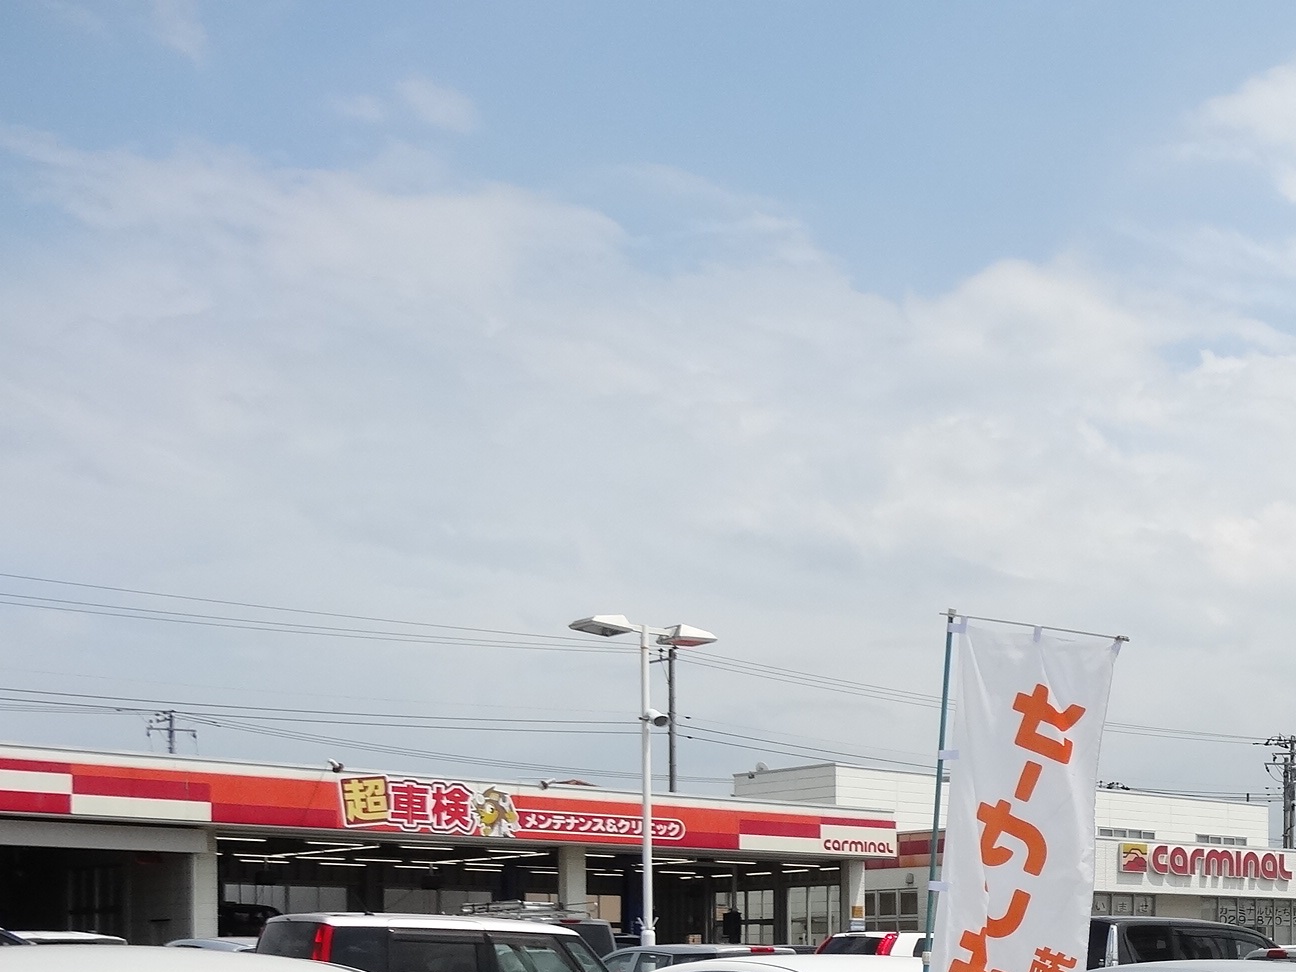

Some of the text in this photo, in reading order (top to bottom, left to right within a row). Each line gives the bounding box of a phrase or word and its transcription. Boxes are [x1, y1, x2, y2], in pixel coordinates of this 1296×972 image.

[343, 778, 472, 828] 超車検
[823, 839, 894, 854] carminal
[1152, 844, 1293, 881] carminal
